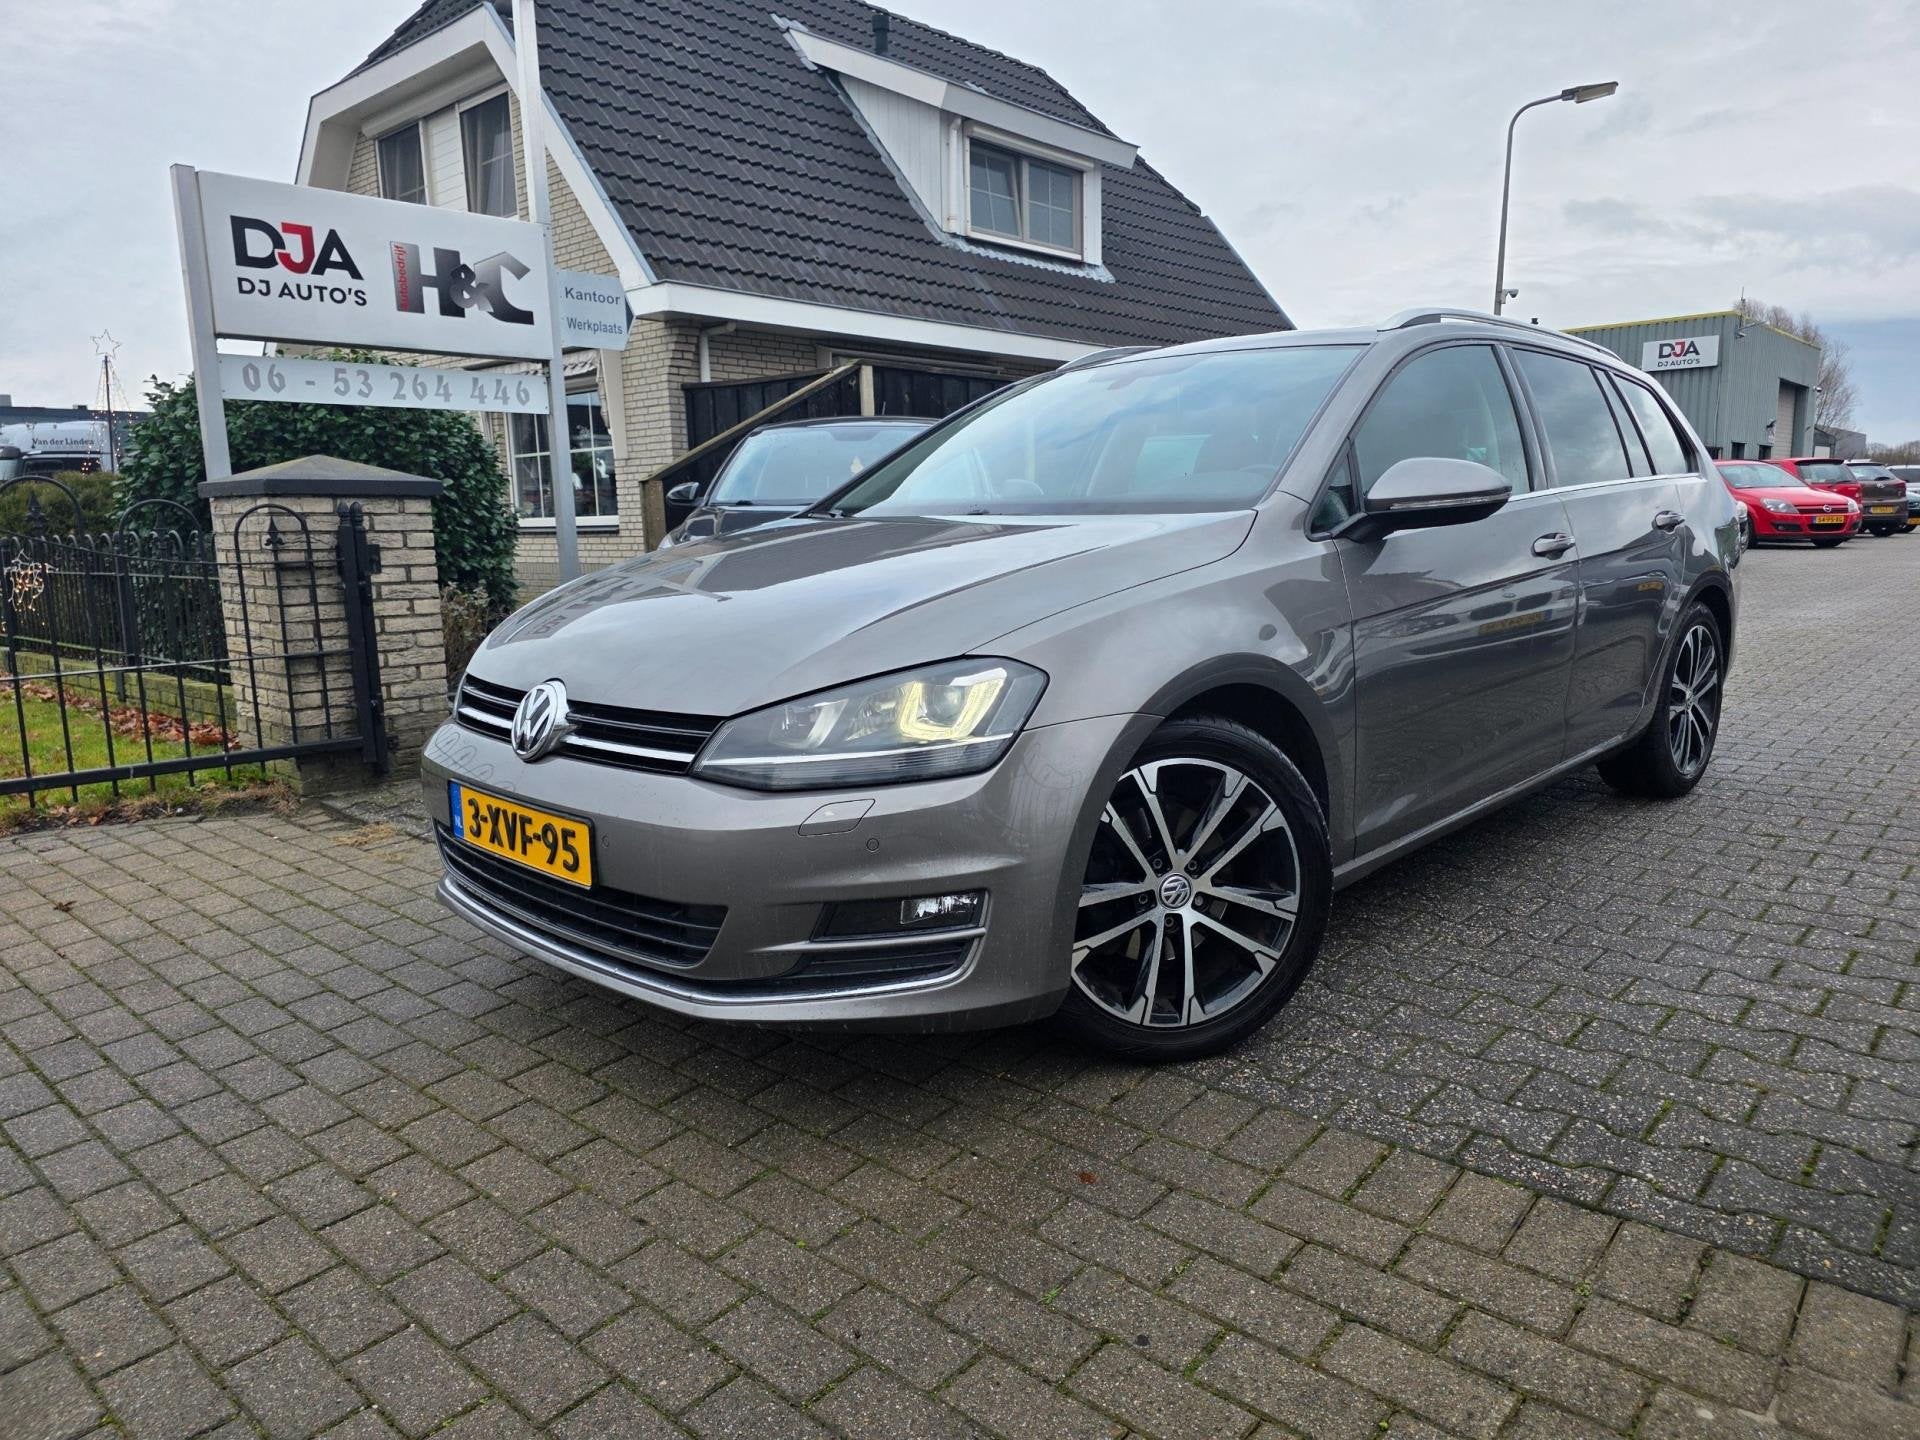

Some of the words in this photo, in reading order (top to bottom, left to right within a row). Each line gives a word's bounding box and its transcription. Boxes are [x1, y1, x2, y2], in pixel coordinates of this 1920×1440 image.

[230, 215, 365, 281] DJA
[237, 277, 271, 297] DJ
[278, 282, 367, 307] AUTO'S
[389, 240, 535, 325] H&C
[564, 286, 621, 305] Kantoor
[566, 316, 624, 335] Werkplaats
[1658, 340, 1701, 359] DJA
[1669, 358, 1701, 367] AUTO'S
[242, 362, 286, 394] 06
[334, 367, 373, 398] 53
[389, 371, 453, 402] 264
[469, 376, 530, 406] 446
[32, 438, 48, 446] Van
[49, 438, 63, 446] der
[468, 798, 580, 873] 3-XVF-95
